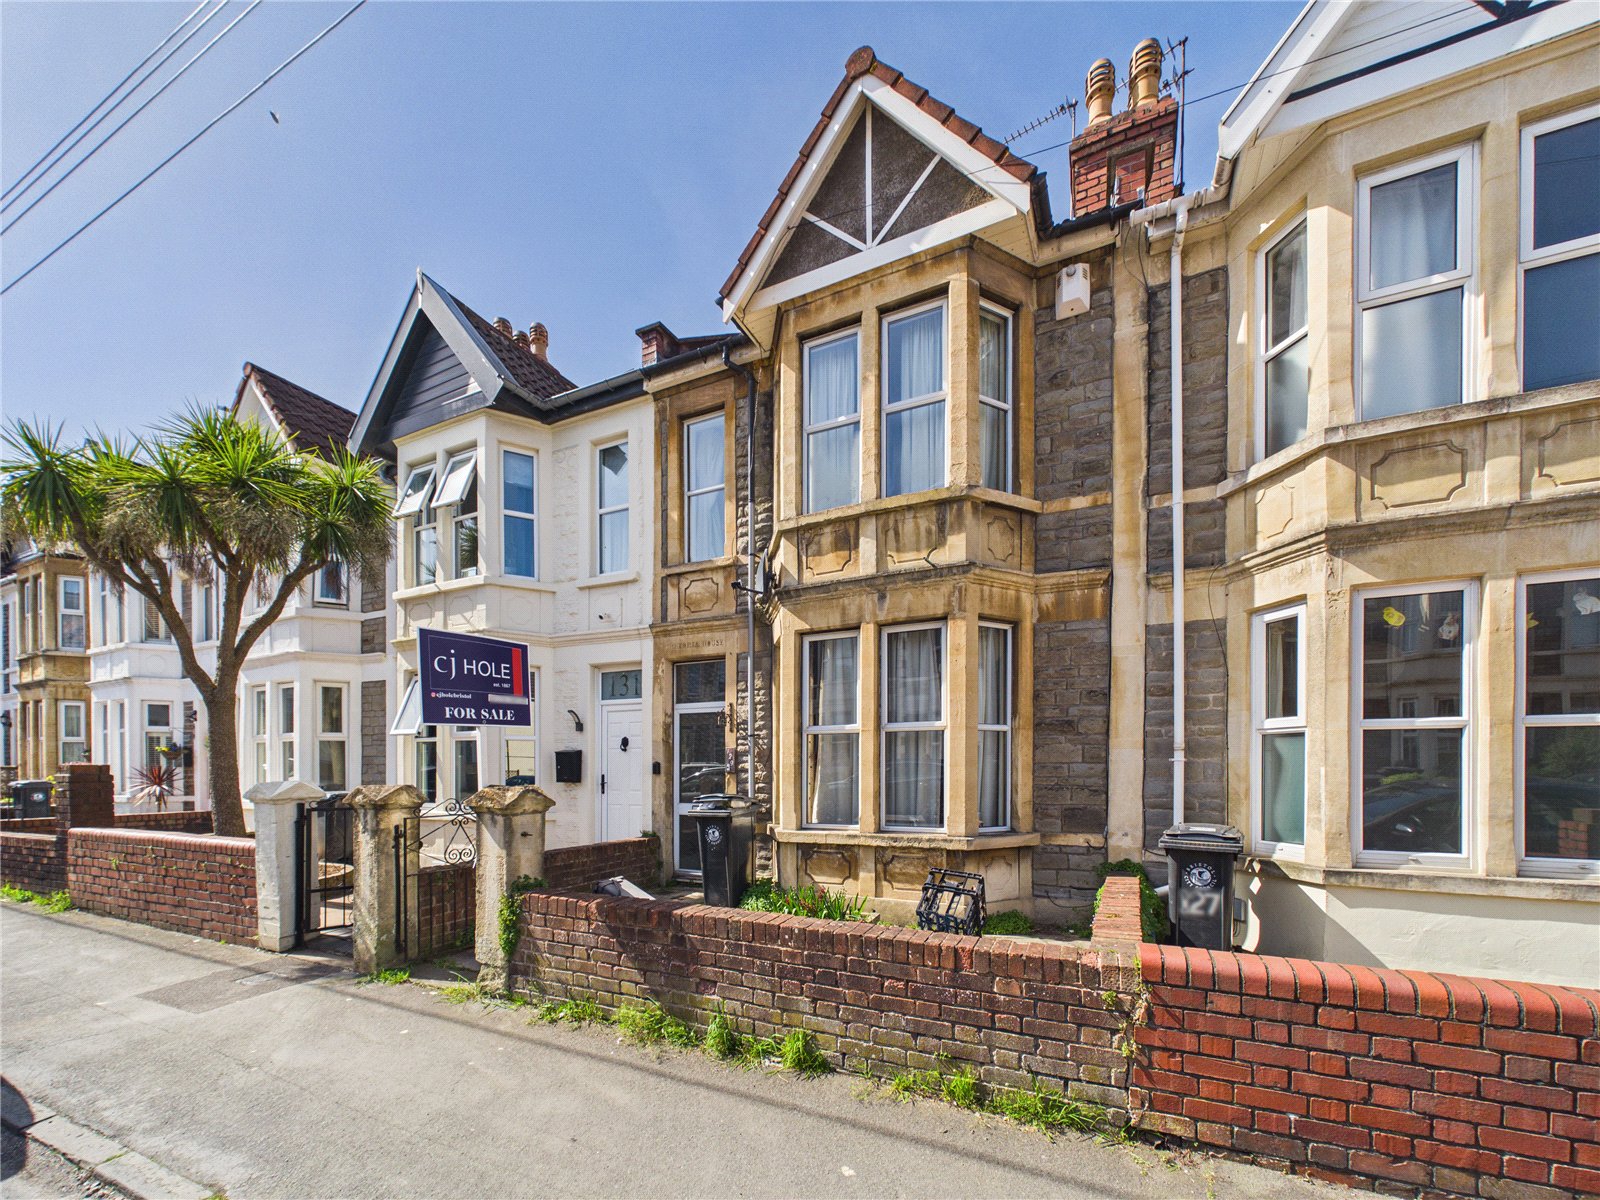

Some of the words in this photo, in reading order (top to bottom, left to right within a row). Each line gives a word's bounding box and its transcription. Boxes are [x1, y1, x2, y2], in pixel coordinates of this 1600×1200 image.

[463, 658, 511, 679] HOLE
[610, 674, 641, 697] 131
[444, 706, 477, 719] FOR
[481, 708, 515, 720] SALE
